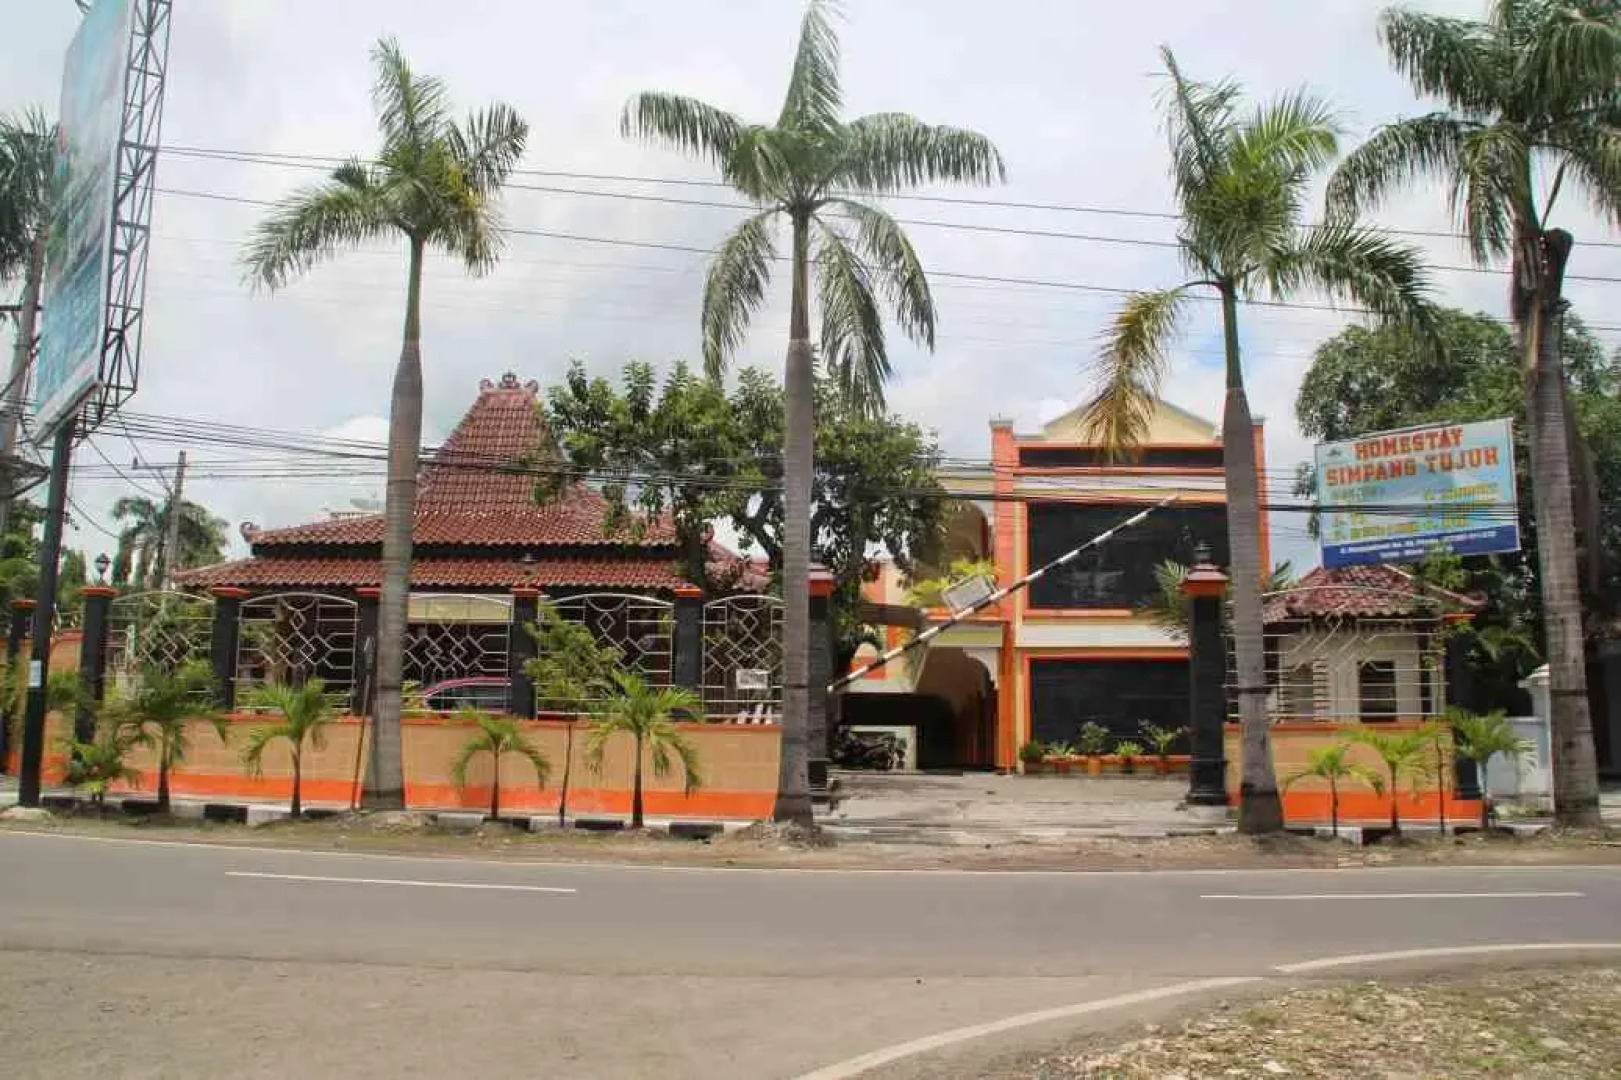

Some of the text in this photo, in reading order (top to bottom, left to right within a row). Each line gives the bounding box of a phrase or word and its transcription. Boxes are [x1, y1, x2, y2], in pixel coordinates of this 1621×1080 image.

[1354, 427, 1463, 460] HOMESTAY
[1325, 448, 1498, 486] SIMPANG TUJUH
